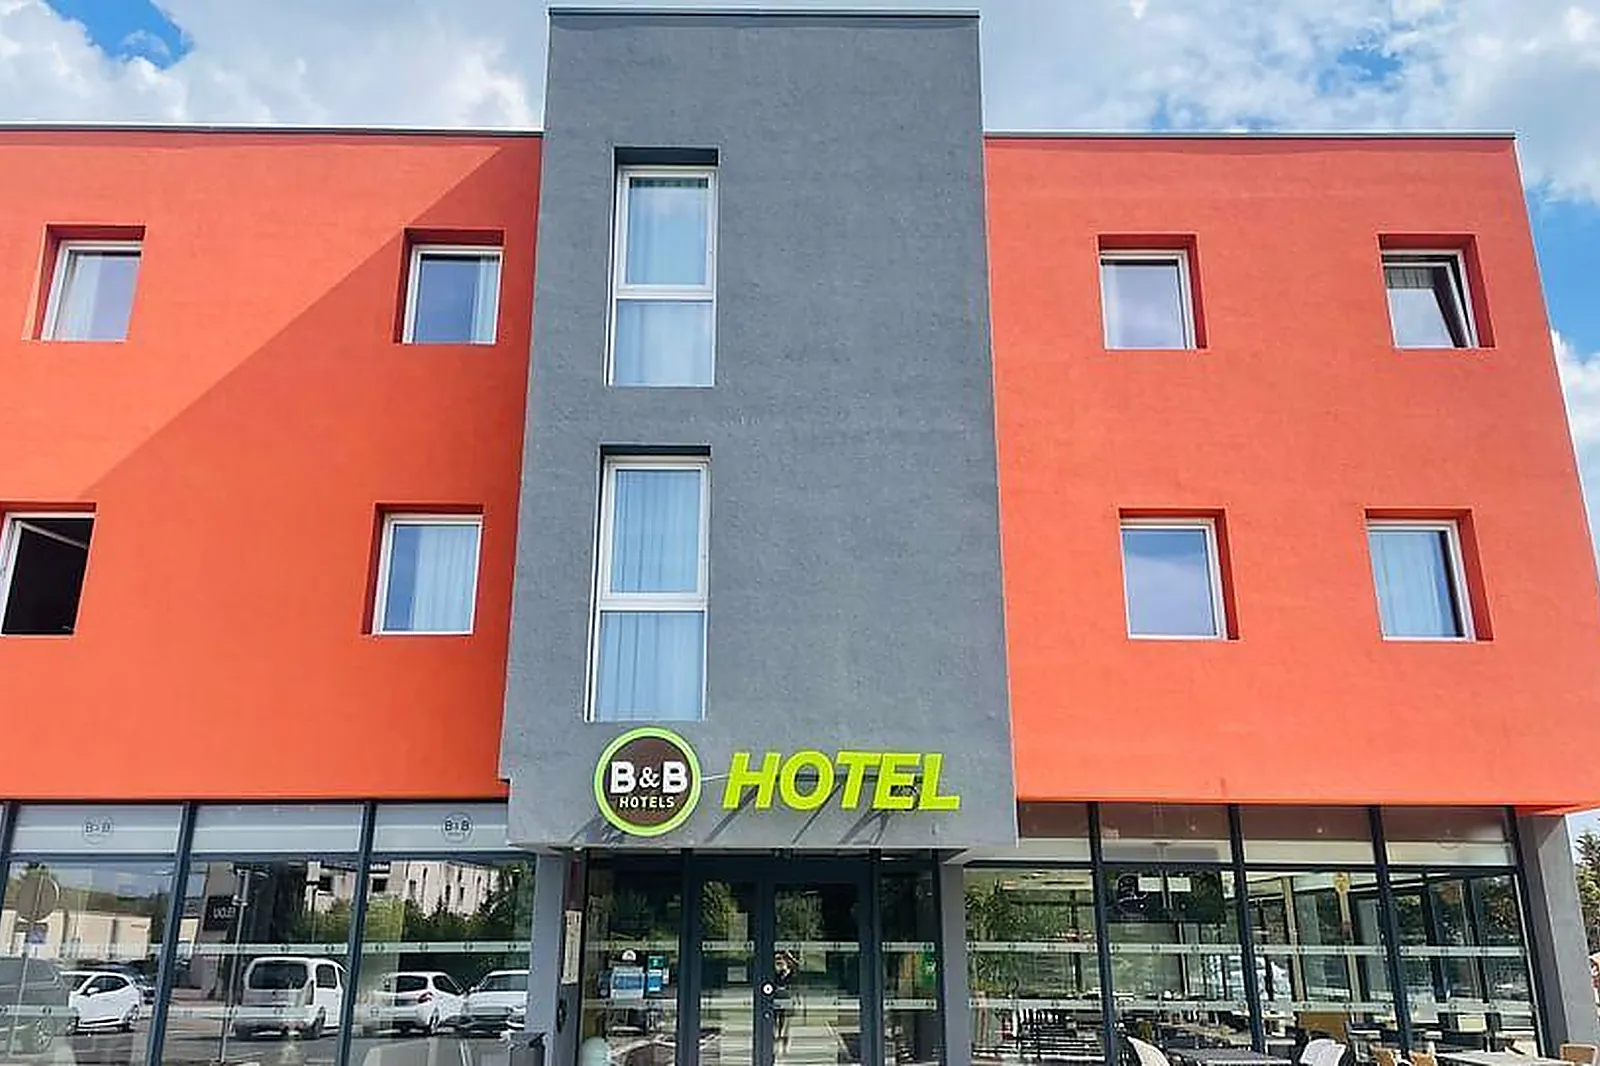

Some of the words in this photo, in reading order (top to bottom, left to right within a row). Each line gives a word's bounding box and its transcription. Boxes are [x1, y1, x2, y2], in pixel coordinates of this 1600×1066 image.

[610, 761, 688, 793] B&B
[722, 751, 960, 811] HOTEL
[619, 796, 675, 809] HOTELS
